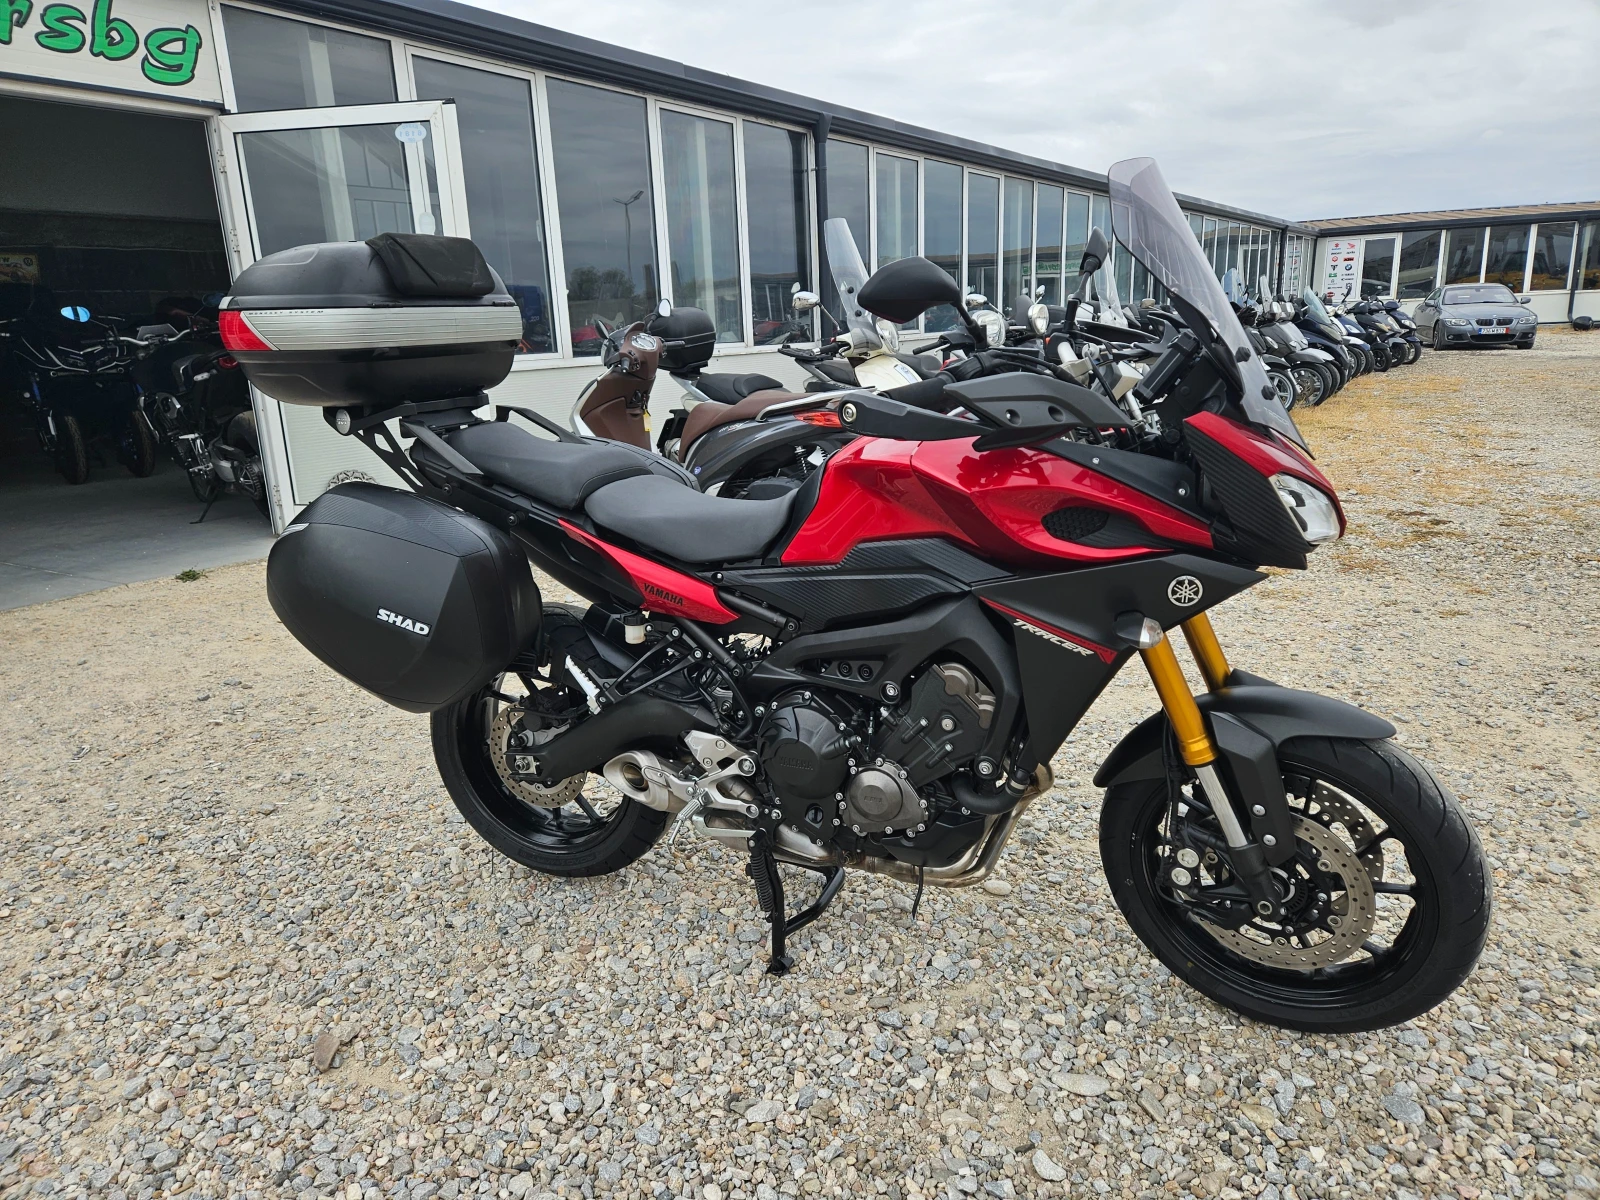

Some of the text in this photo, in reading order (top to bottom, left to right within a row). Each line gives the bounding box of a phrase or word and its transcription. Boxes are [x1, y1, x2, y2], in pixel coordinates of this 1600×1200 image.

[643, 582, 684, 607] YAMAHA
[376, 608, 430, 635] SHAD
[1013, 618, 1095, 657] TRACER
[780, 756, 813, 771] YAMAHA
